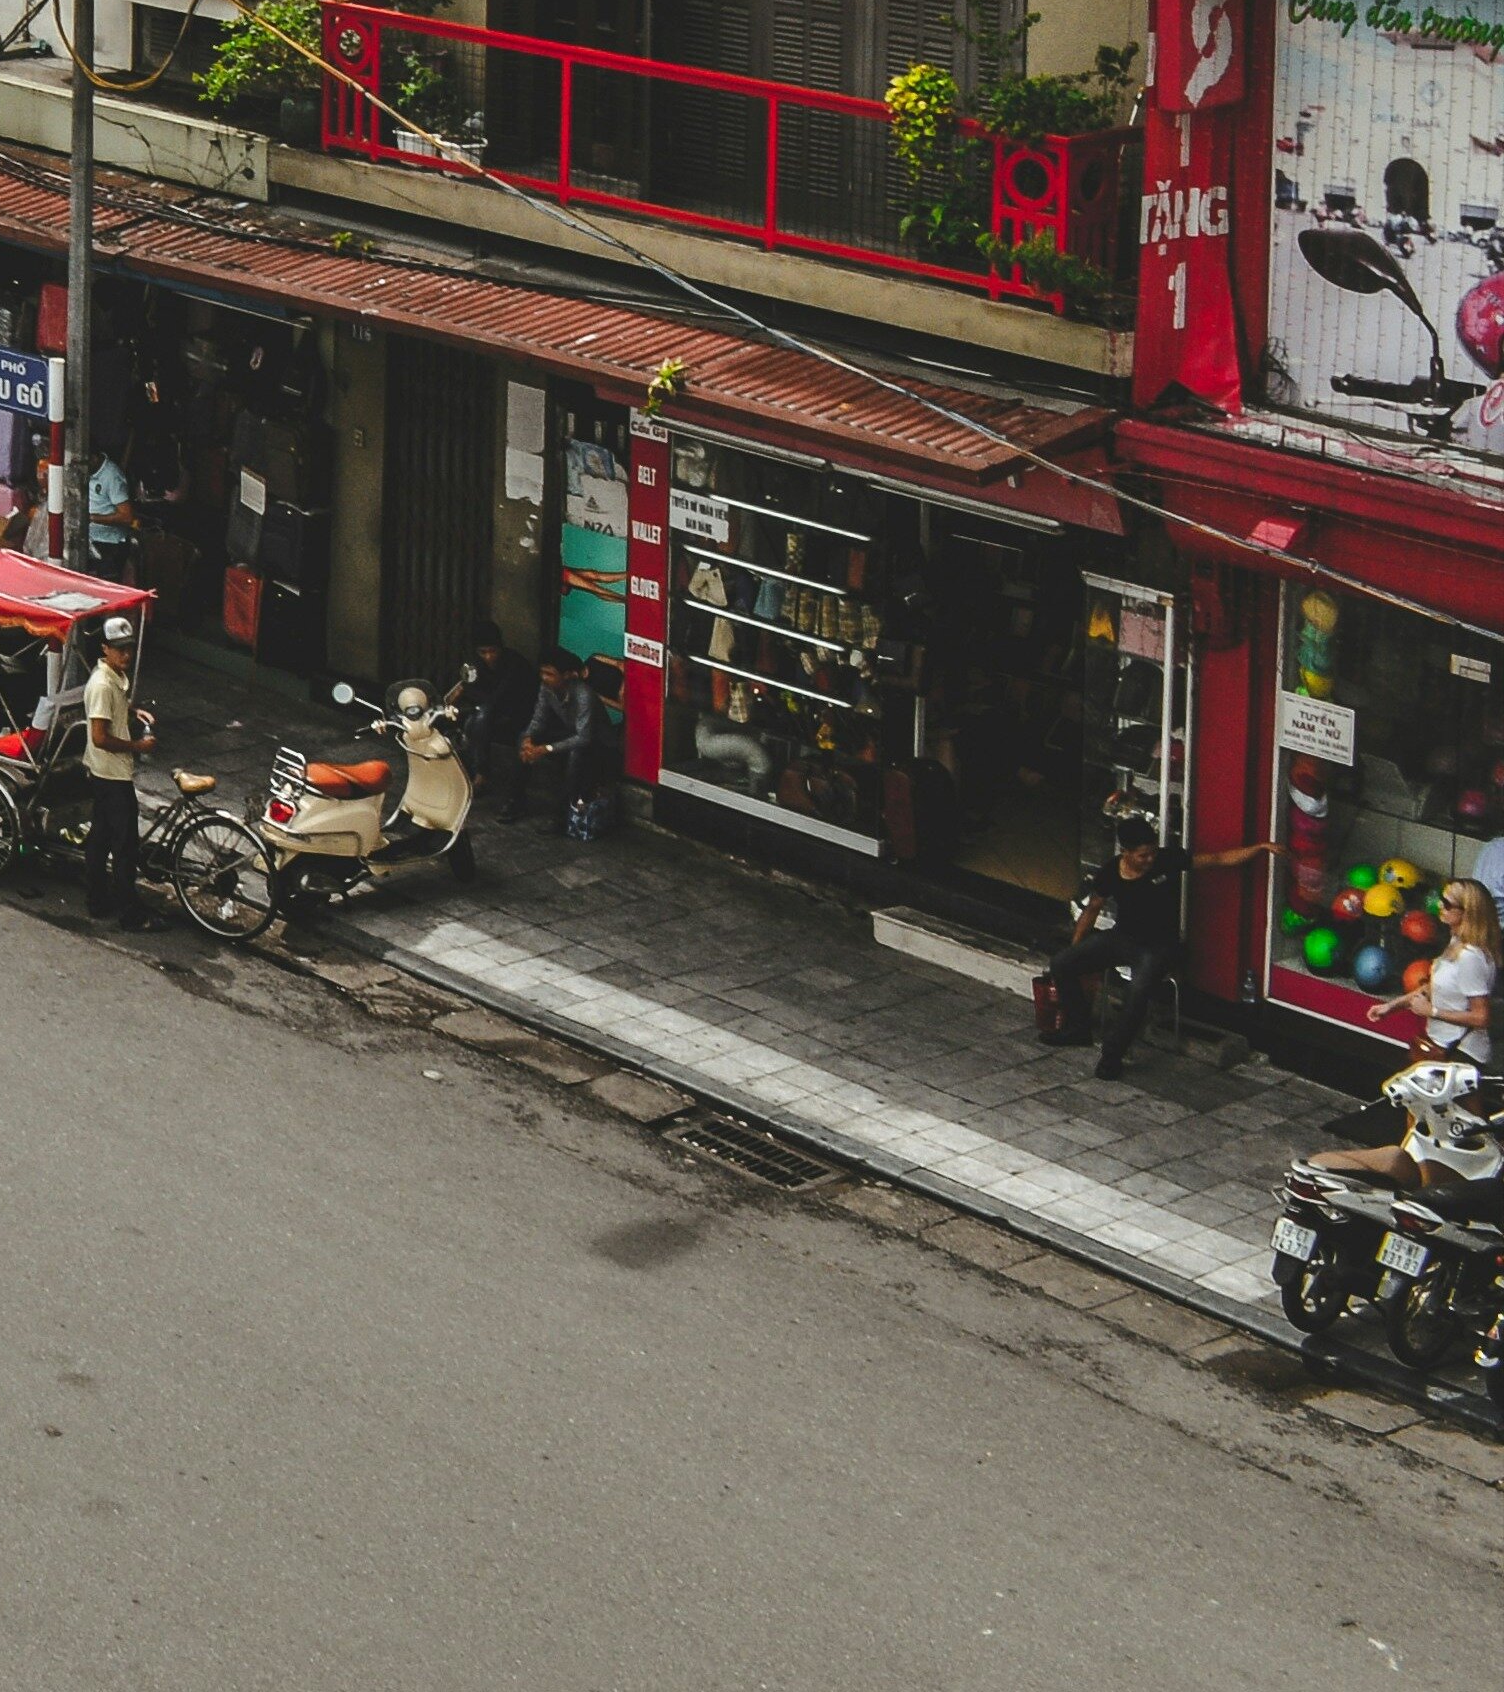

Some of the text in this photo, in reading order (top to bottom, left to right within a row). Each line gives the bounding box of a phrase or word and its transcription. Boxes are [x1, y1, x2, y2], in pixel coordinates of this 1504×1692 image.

[1168, 262, 1187, 330] 1
[0, 358, 27, 376] PHỐ
[15, 380, 45, 409] GỖ
[638, 465, 657, 487] BELT
